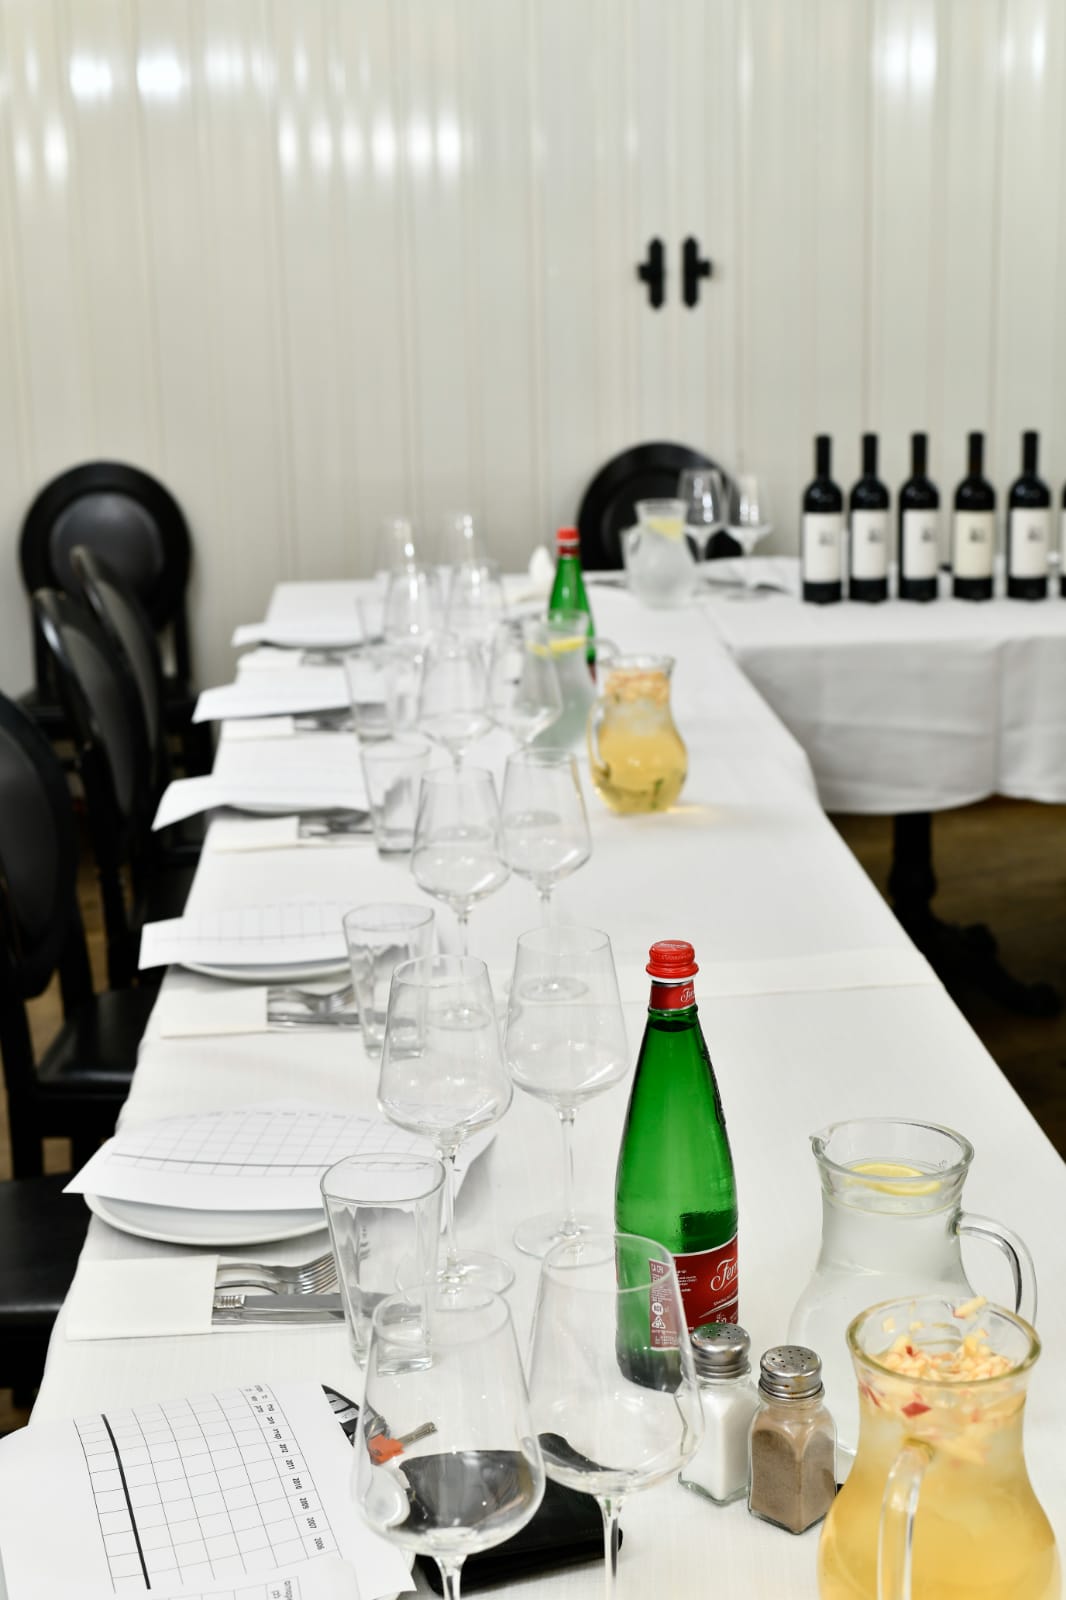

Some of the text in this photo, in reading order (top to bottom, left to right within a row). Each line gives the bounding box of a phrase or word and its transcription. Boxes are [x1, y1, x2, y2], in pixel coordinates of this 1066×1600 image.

[285, 1459, 295, 1470] 2011
[292, 1477, 302, 1489] 2010
[306, 1517, 317, 1529] 2007
